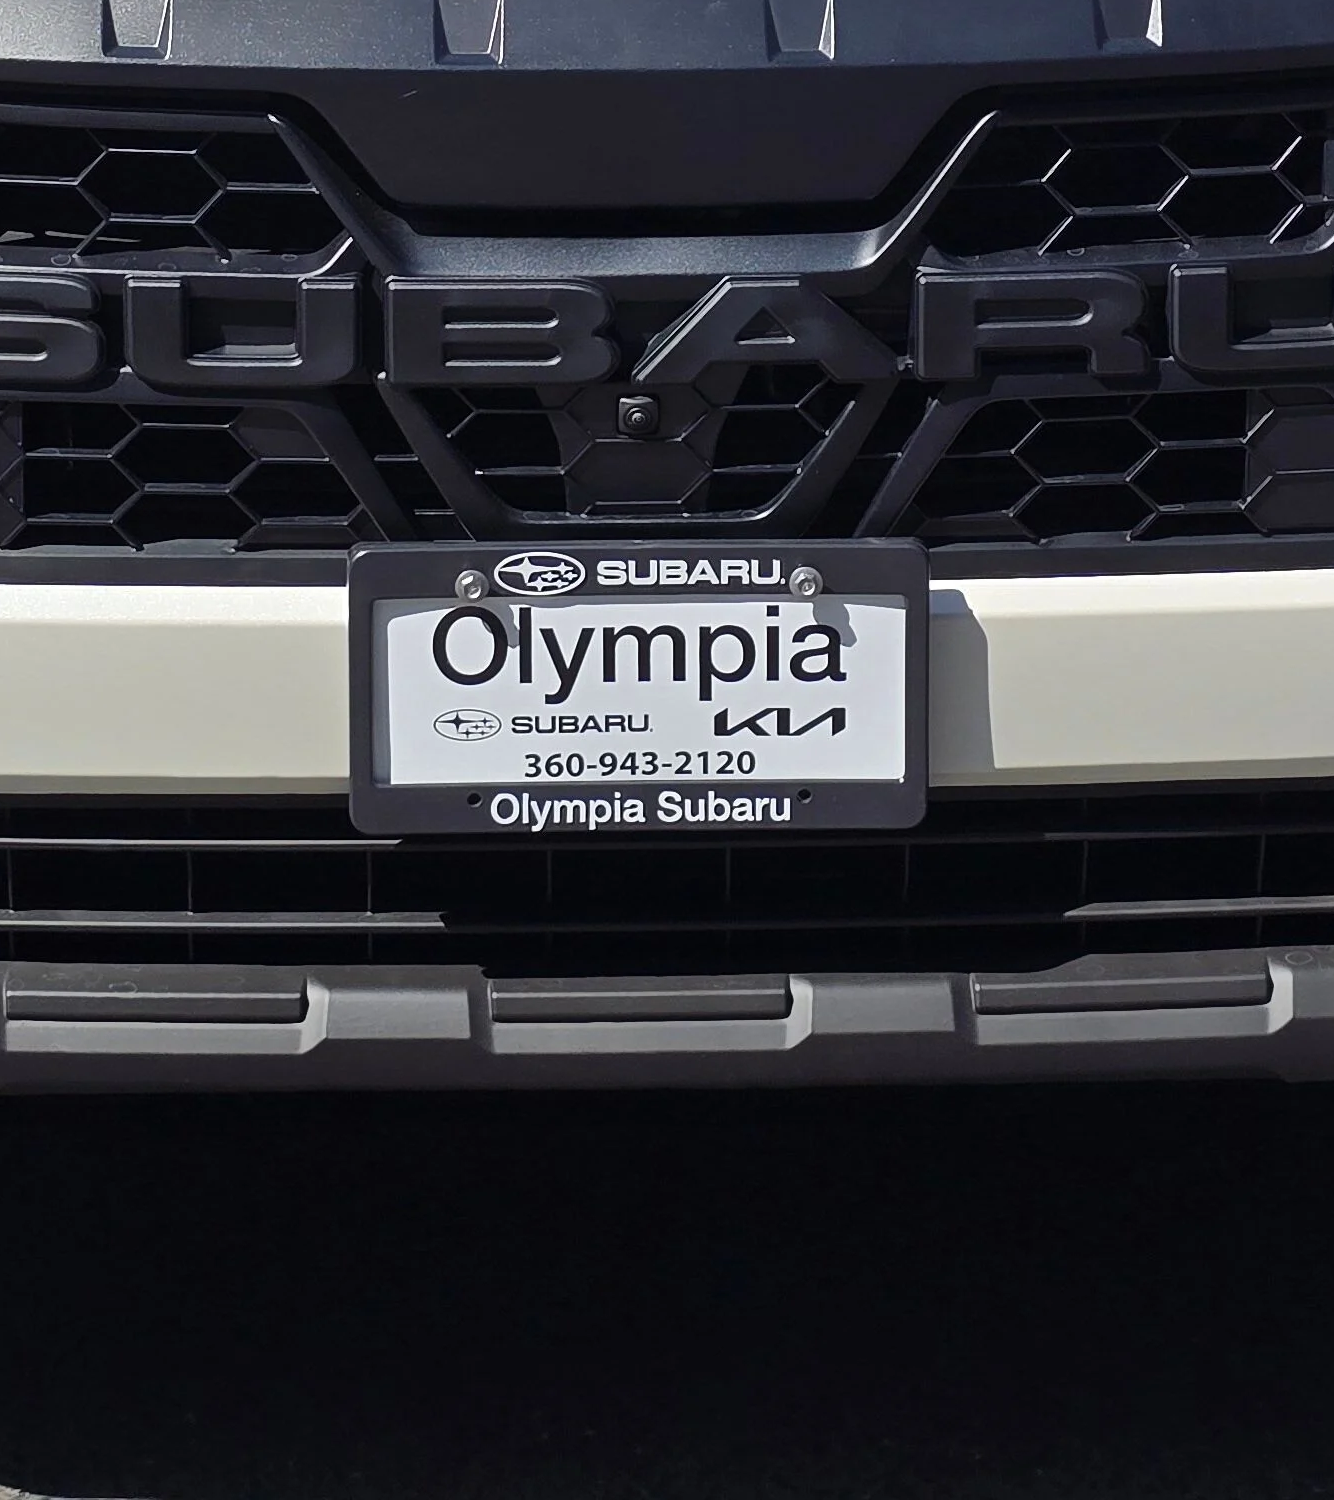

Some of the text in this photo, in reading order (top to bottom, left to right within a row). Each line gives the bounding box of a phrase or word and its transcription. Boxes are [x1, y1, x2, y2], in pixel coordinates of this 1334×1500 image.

[596, 558, 785, 587] SUBARU
[432, 605, 848, 705] Olympia
[510, 707, 847, 737] SUBARU KIA
[524, 750, 756, 779] 360-943-2120
[490, 790, 792, 832] Olympia Subaru
